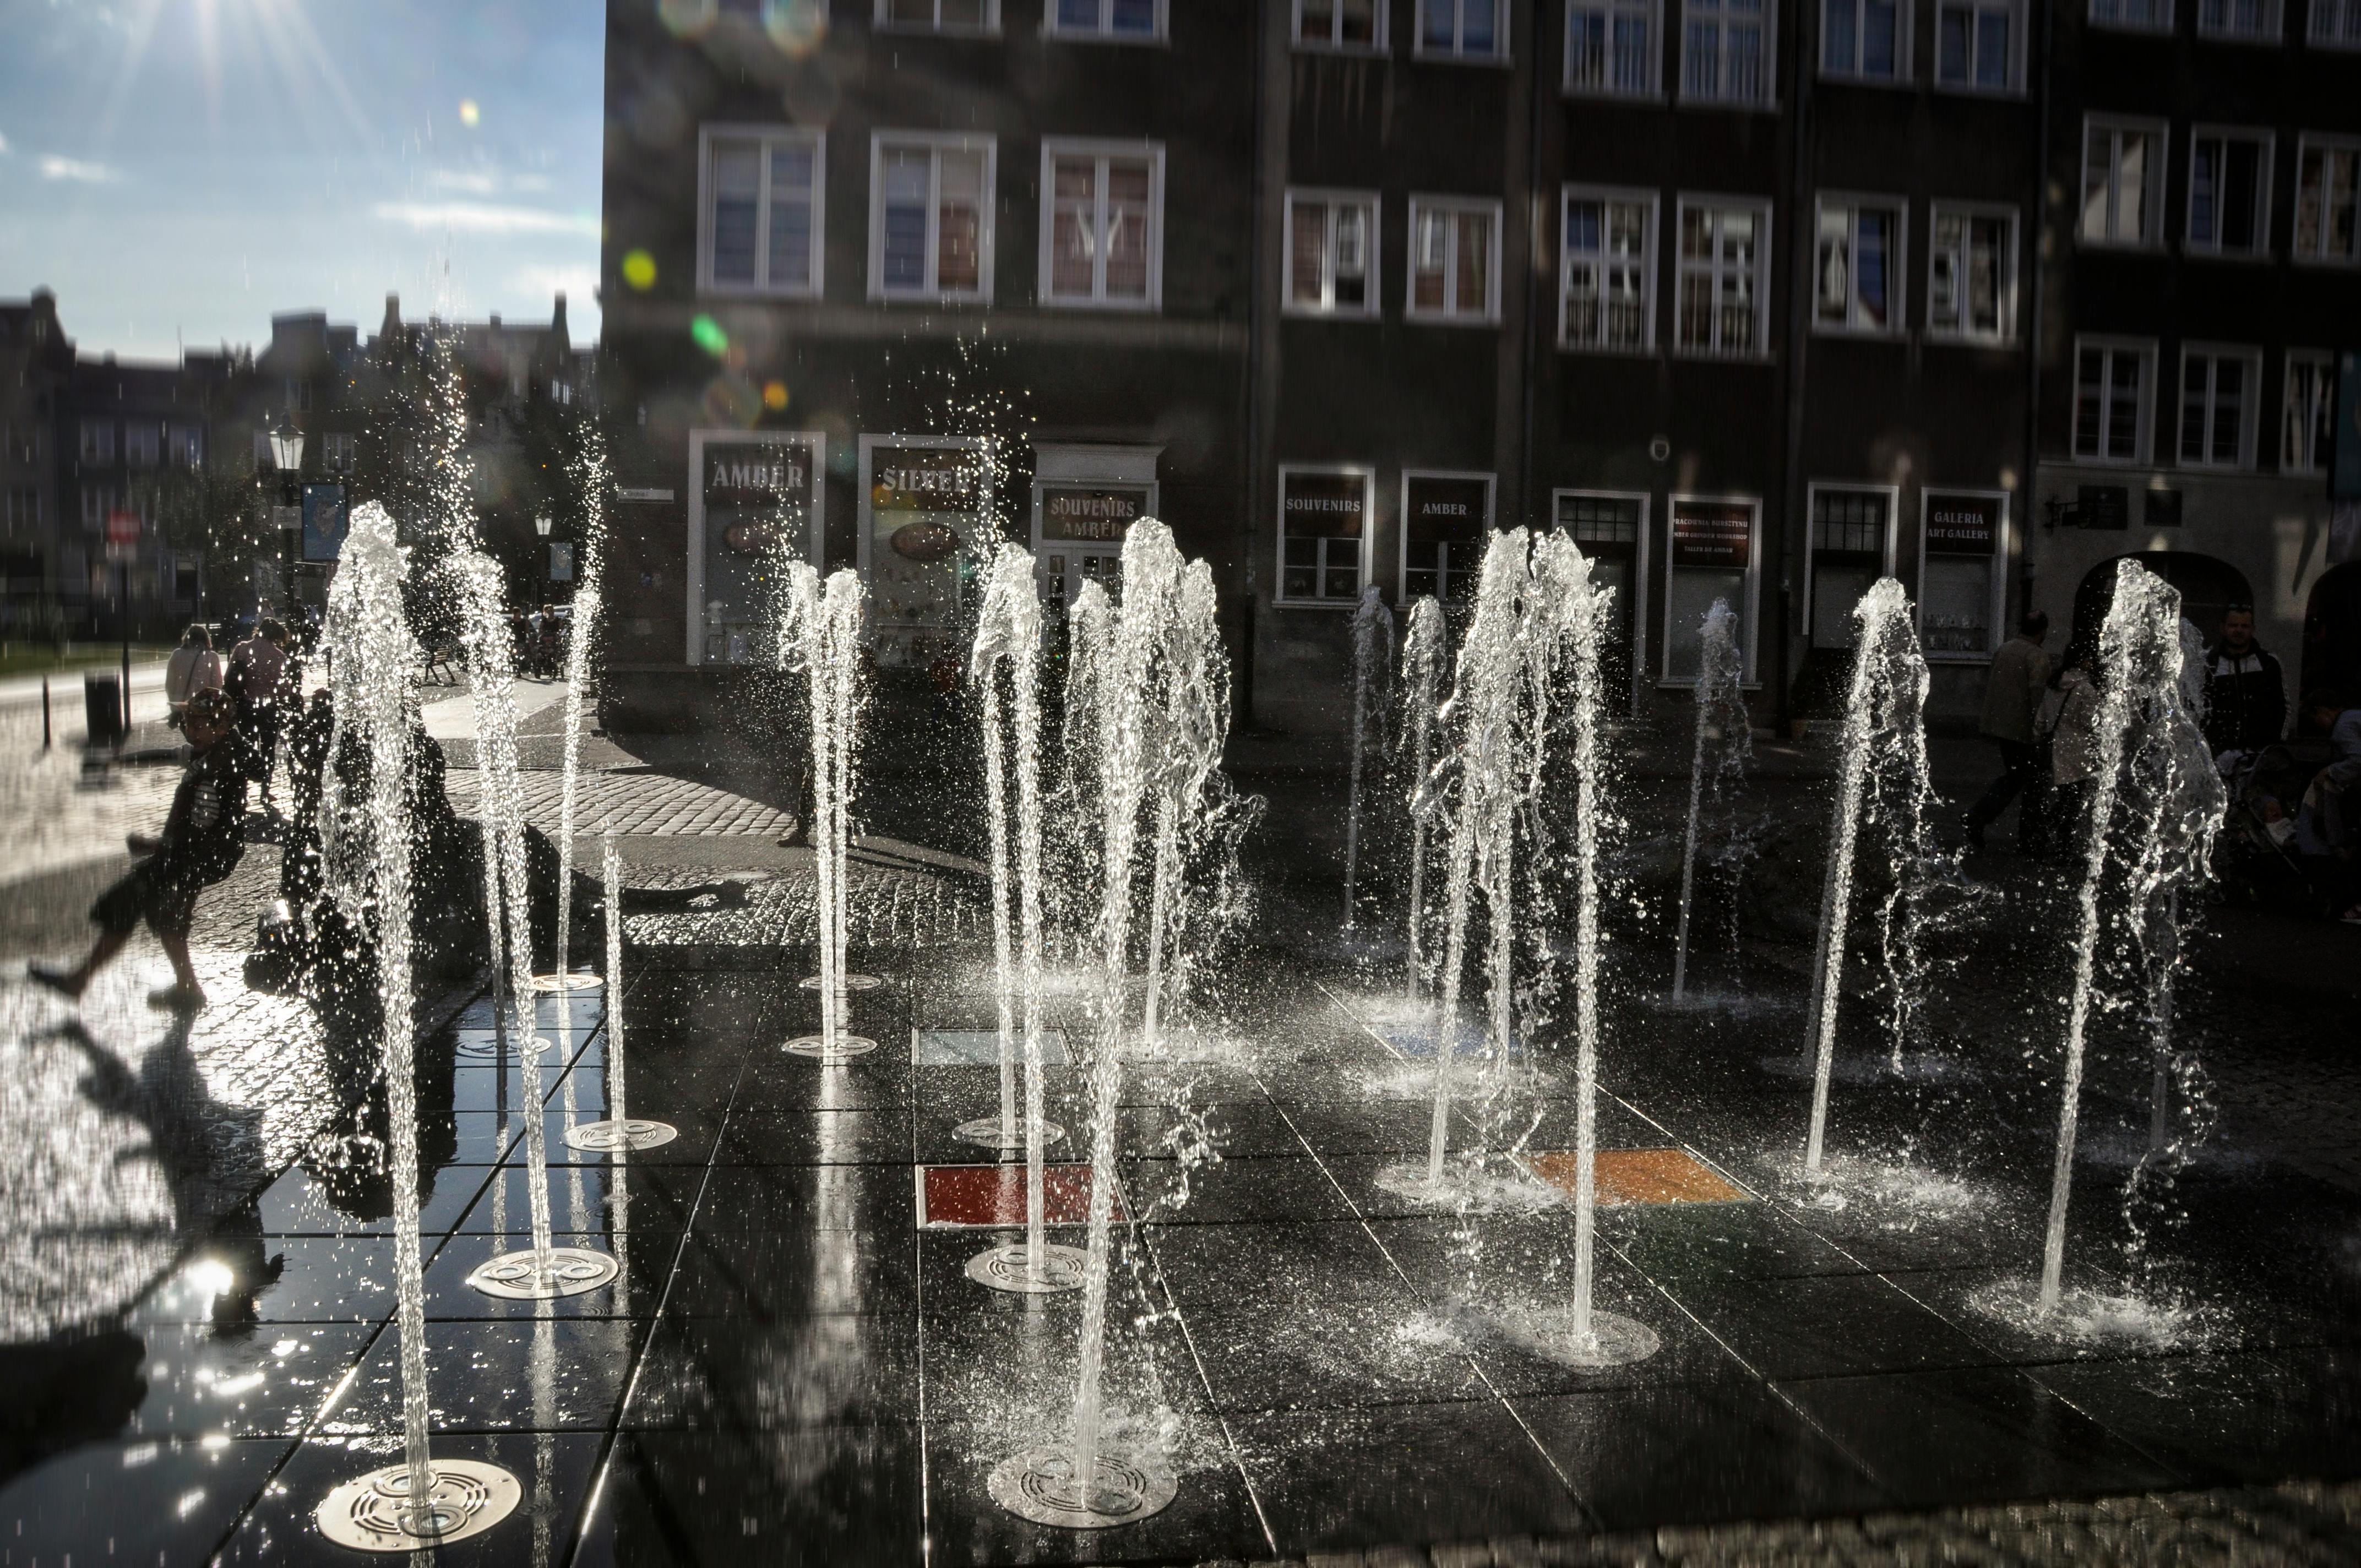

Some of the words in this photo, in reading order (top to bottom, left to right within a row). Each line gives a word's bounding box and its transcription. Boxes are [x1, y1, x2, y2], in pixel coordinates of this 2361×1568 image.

[712, 465, 803, 487] AMBER
[882, 469, 970, 492] SILVER
[1051, 497, 1135, 516] SOUVENIRS
[1286, 498, 1361, 512] SOUVENIRS
[1422, 503, 1467, 515] AMBER
[1934, 511, 1984, 524] GALERIA
[1928, 529, 1945, 537] ART
[1947, 529, 1989, 539] GALLERY
